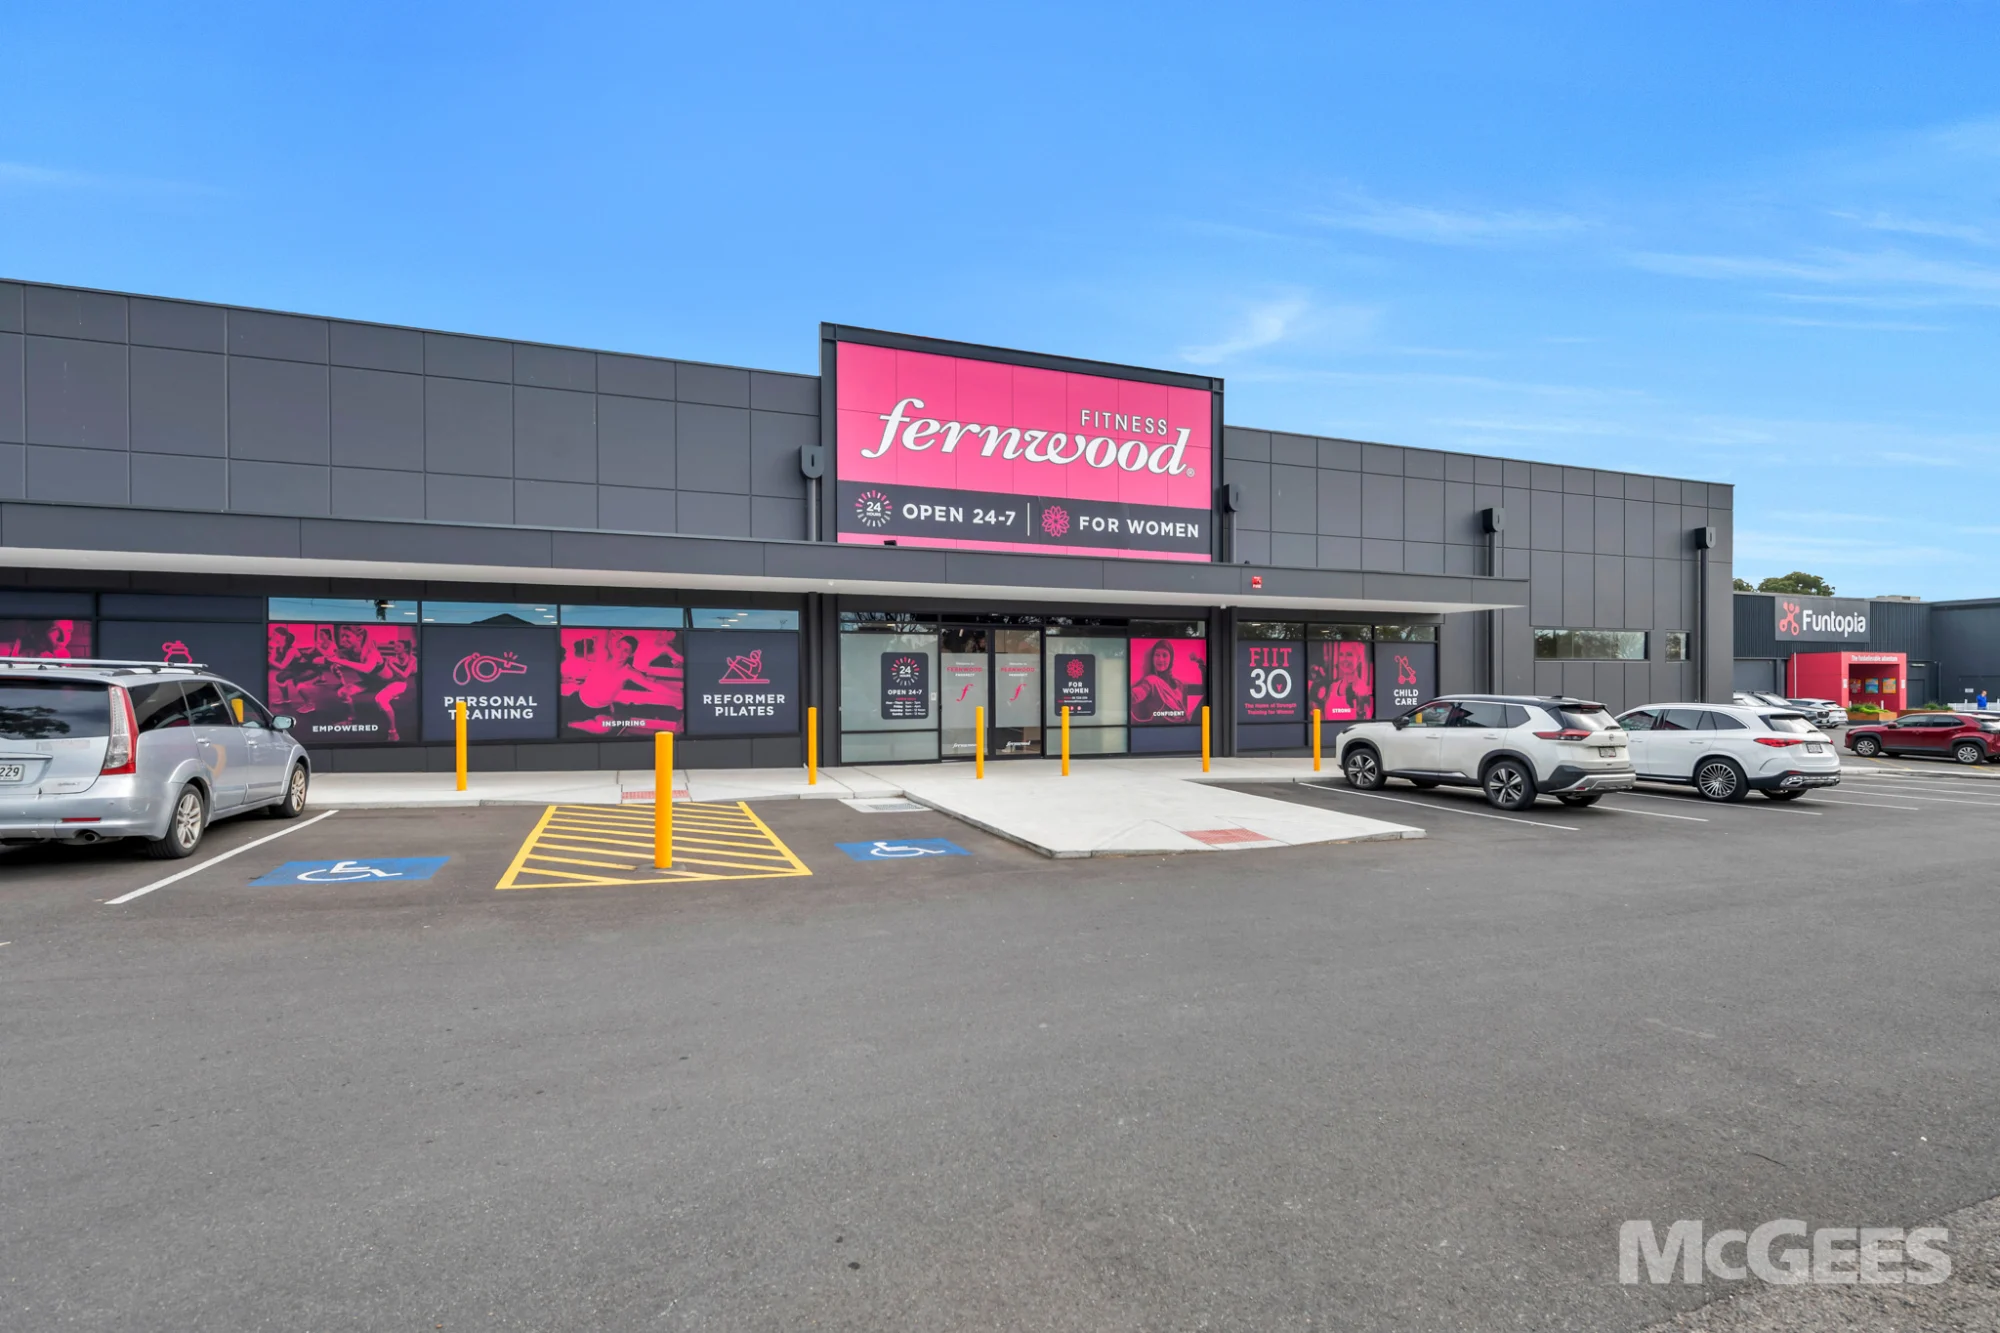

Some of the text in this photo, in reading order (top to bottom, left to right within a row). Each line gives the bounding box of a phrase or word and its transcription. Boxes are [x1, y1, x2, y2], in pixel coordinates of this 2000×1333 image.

[1080, 409, 1168, 436] FITNESS
[866, 501, 882, 512] 24
[902, 503, 1016, 526] OPEN 24-7
[1079, 516, 1199, 538] FOR WOMEN
[1802, 609, 1866, 638] Funtopia
[1249, 647, 1292, 667] FIIT
[899, 665, 911, 674] 24
[1249, 668, 1292, 699] 30
[1393, 688, 1419, 697] CHILD
[703, 694, 786, 704] REFORMER
[1394, 697, 1418, 706] CARE
[715, 706, 775, 717] PILATES
[312, 723, 379, 733] EMPOWERED
[602, 720, 646, 728] INSPIRING
